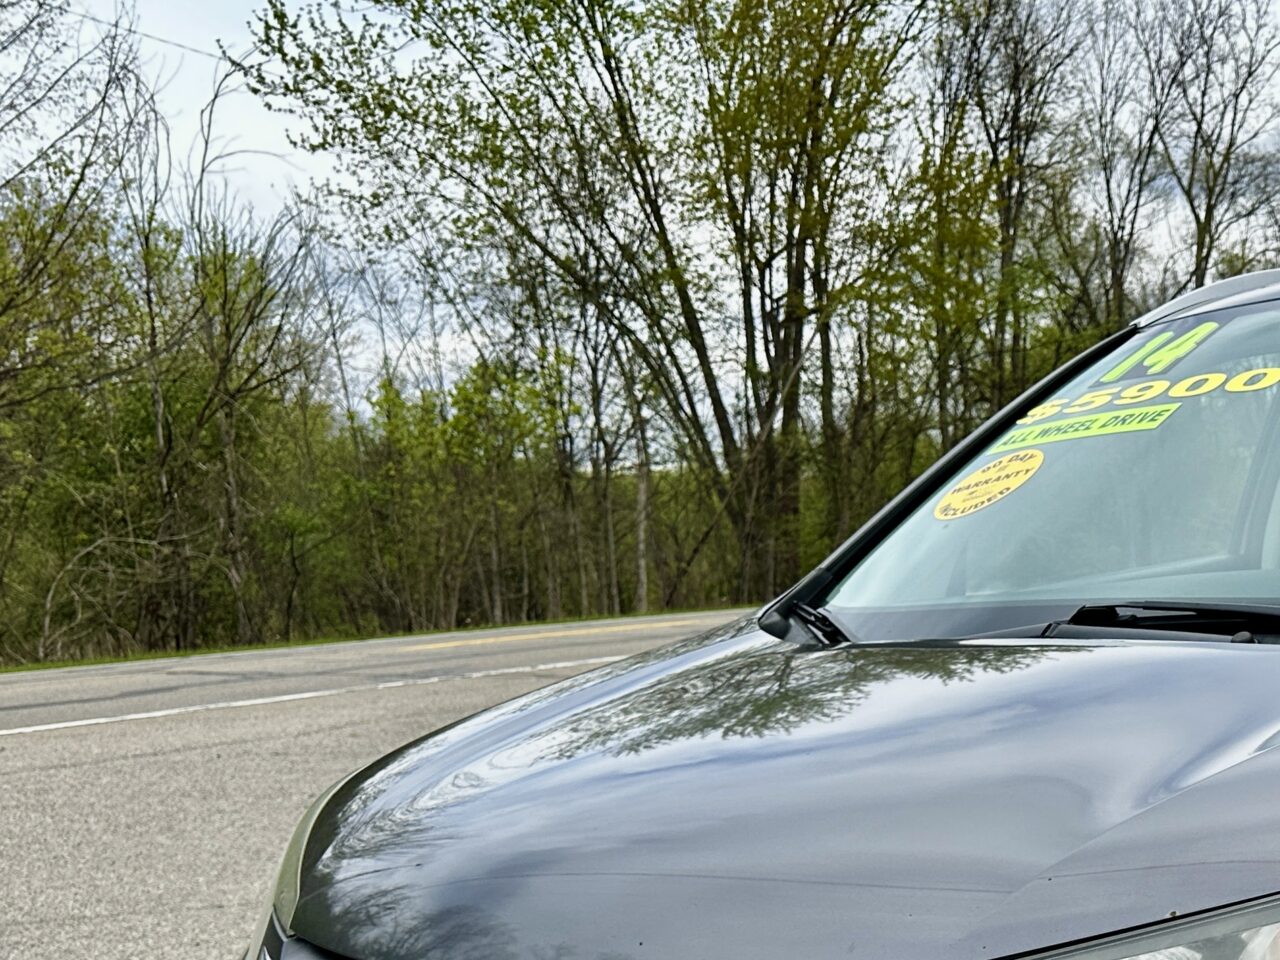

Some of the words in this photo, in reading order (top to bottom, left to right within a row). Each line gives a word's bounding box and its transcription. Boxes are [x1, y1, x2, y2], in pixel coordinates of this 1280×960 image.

[1002, 430, 1035, 446] ALL
[1033, 418, 1100, 440] WHEEL
[1100, 409, 1171, 429] DRIVE
[951, 467, 1037, 495] WARRANTY
